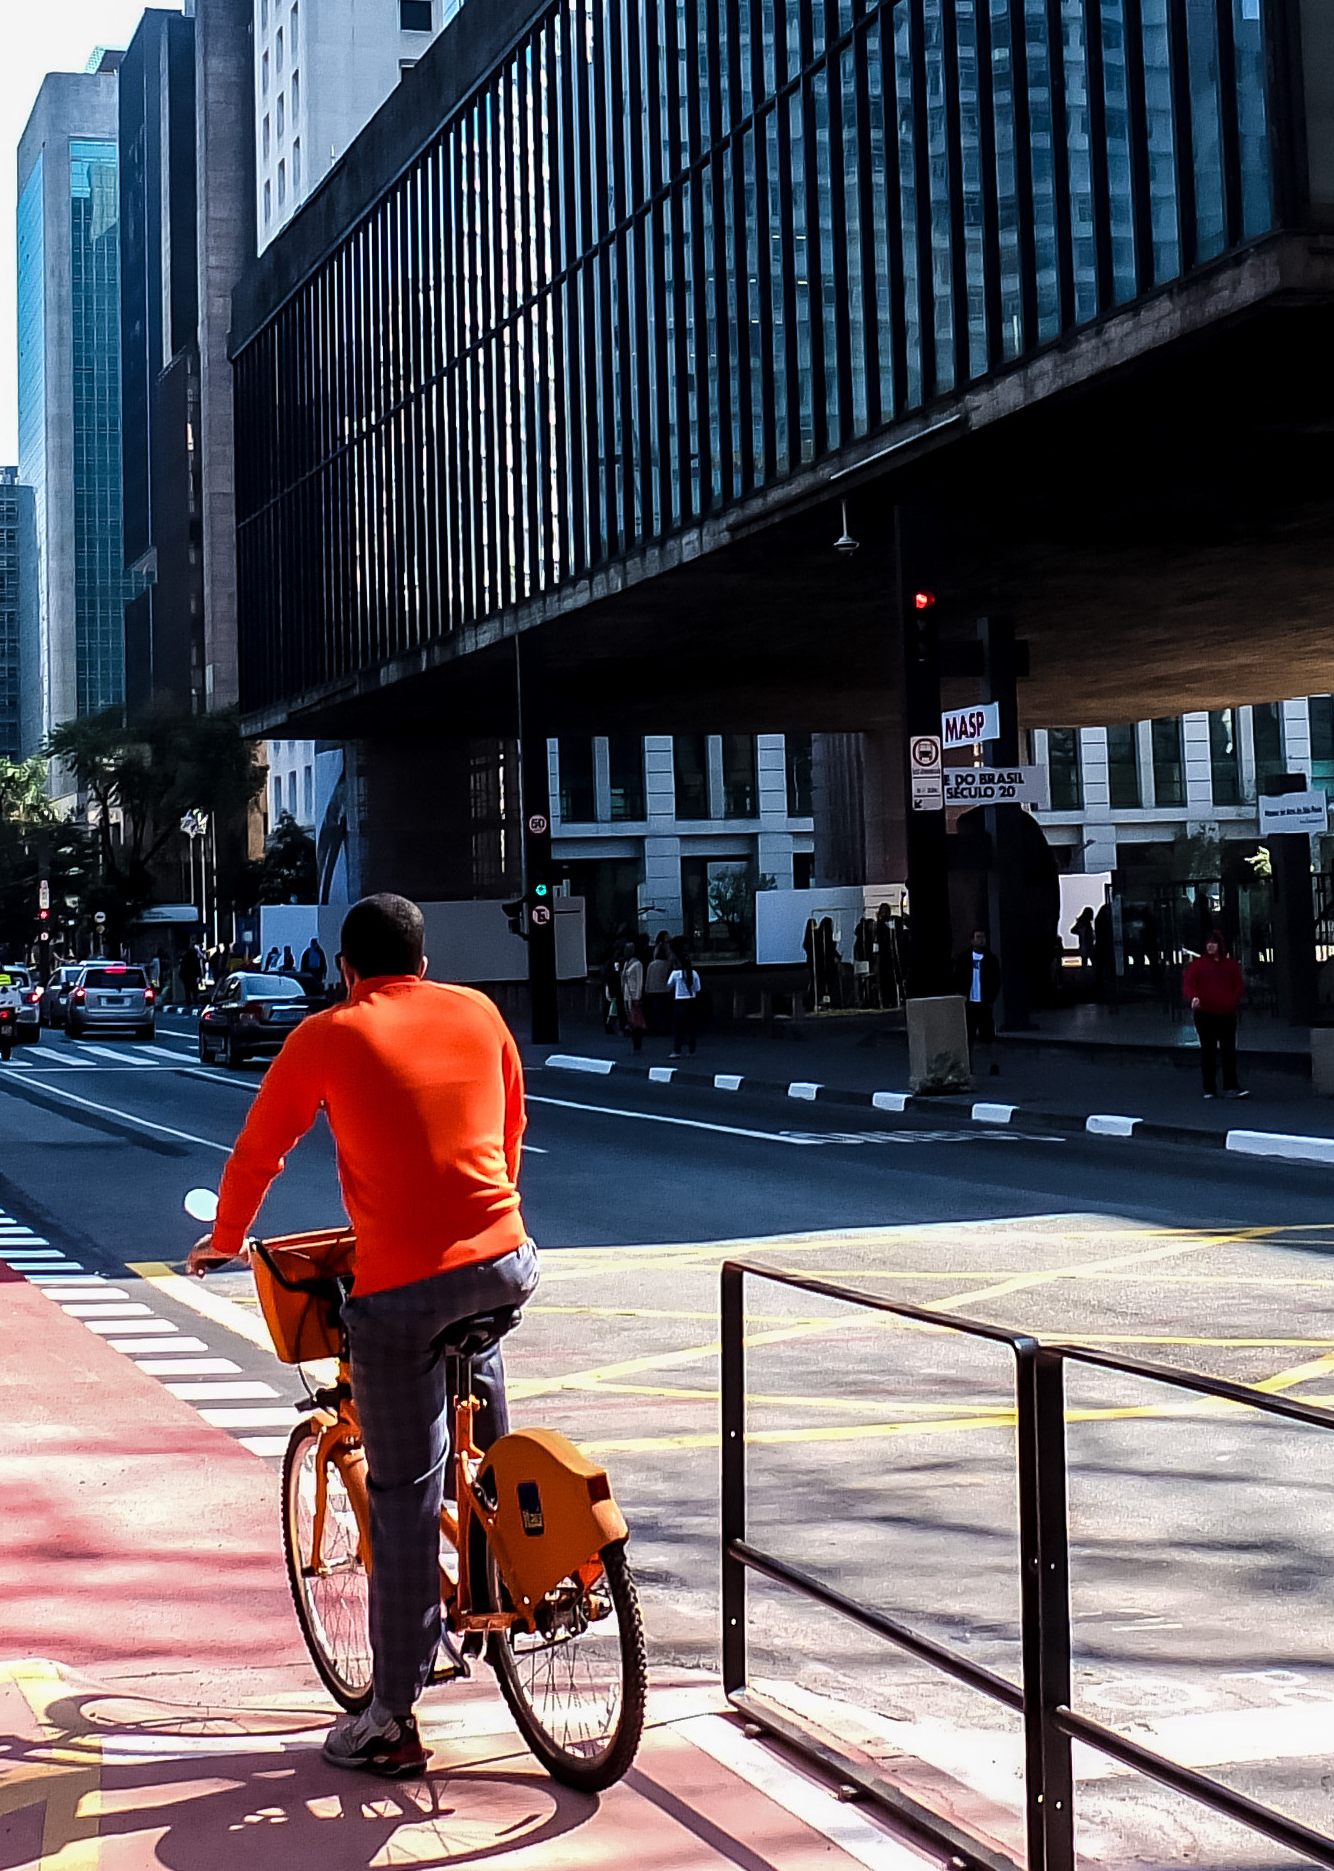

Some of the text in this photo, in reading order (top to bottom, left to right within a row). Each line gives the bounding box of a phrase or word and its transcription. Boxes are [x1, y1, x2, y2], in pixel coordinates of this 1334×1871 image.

[945, 711, 985, 743] MASP
[955, 773, 976, 786] DO
[979, 772, 1025, 785] BRASIL
[999, 785, 1016, 798] 20
